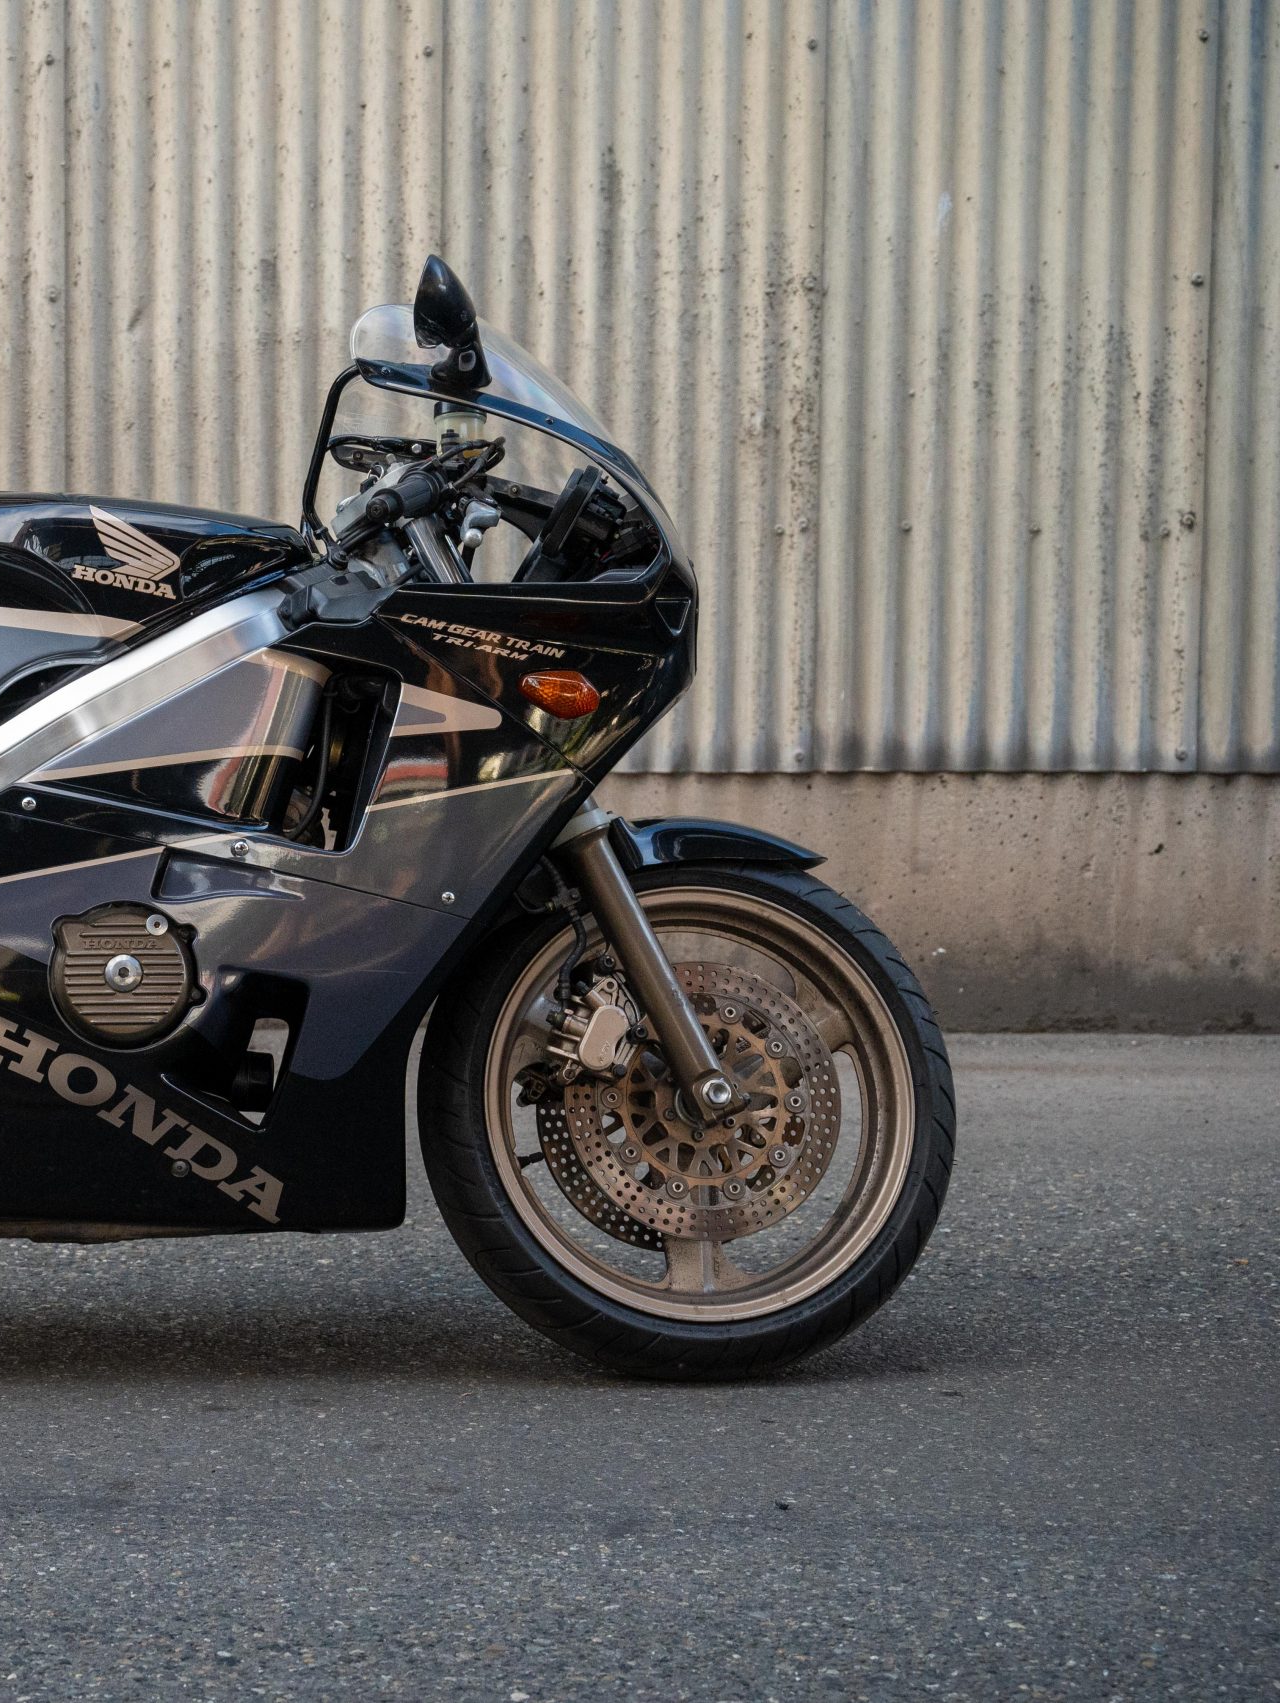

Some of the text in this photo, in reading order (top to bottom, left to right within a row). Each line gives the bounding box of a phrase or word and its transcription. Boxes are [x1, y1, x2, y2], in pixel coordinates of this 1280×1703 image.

[71, 564, 177, 600] HONDA
[400, 613, 565, 659] CAM GEAR TRAIN
[83, 937, 163, 950] HONDA
